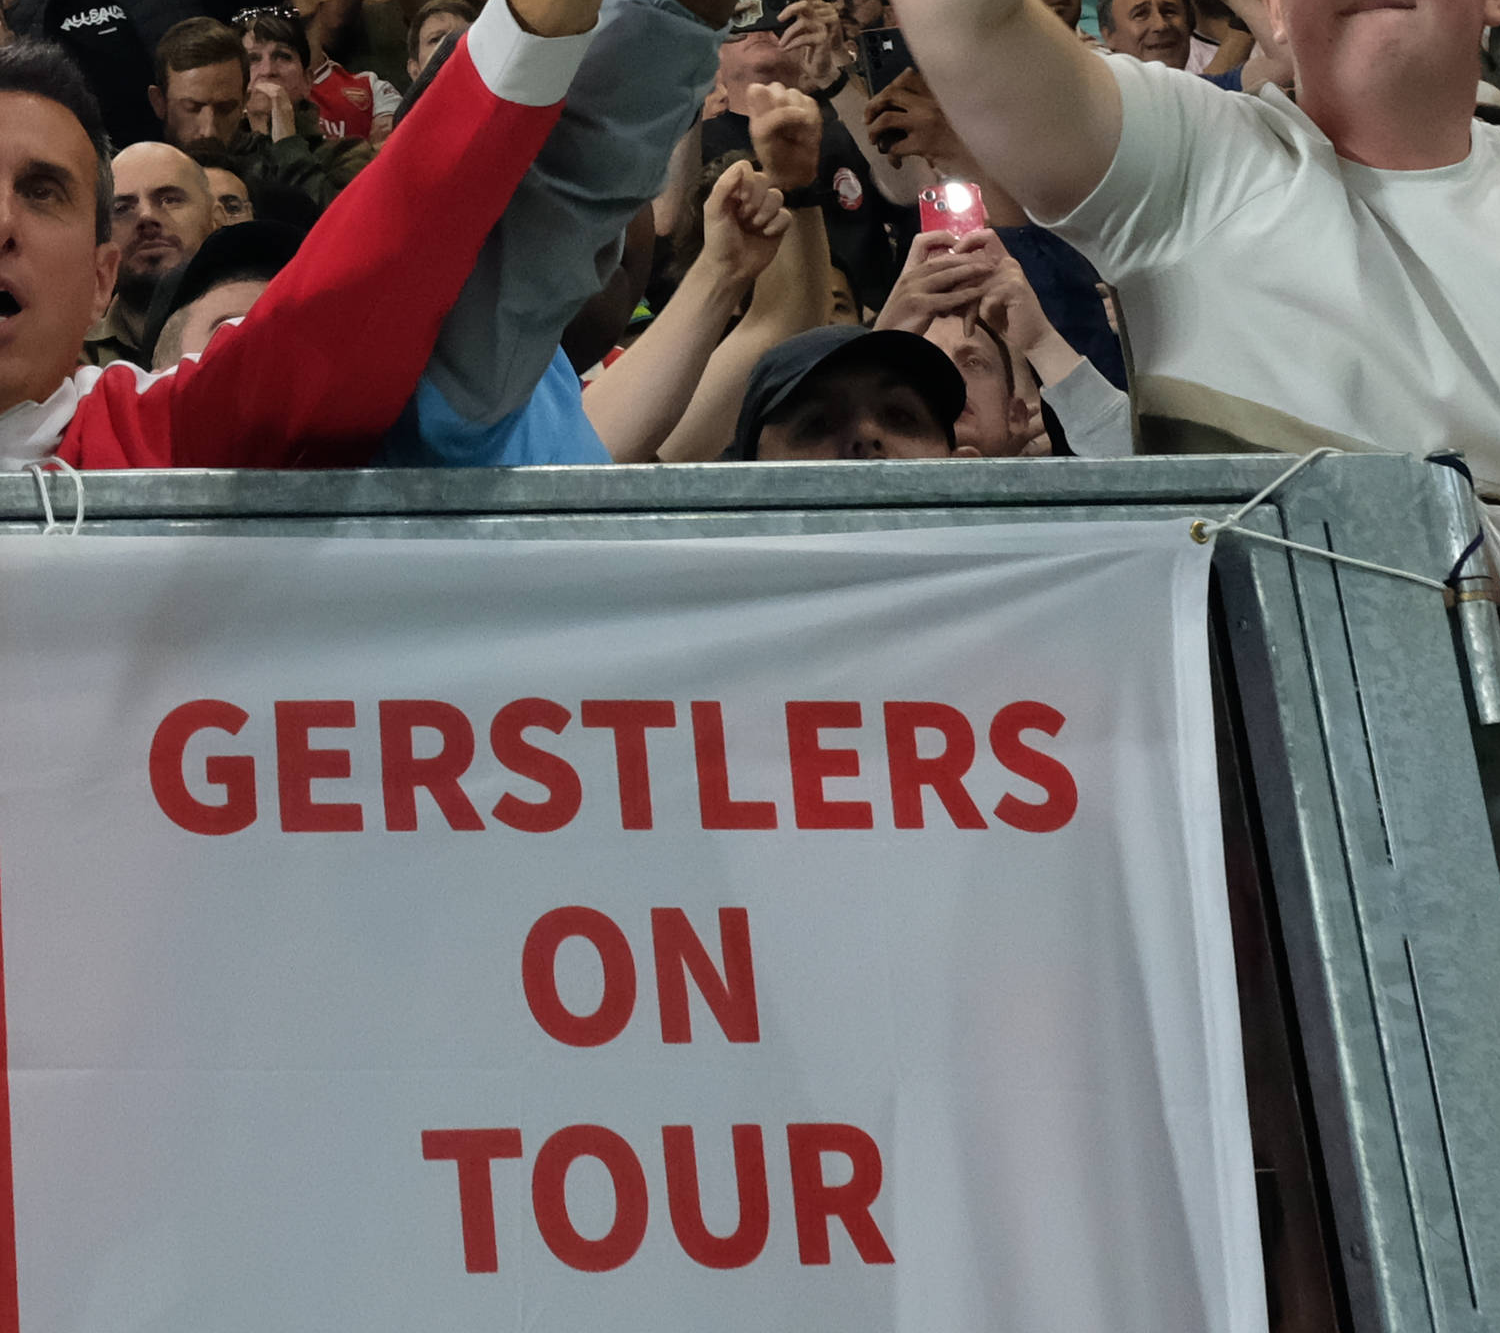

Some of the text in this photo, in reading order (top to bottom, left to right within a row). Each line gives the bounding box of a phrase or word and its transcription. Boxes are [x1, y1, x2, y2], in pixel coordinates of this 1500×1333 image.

[149, 698, 1078, 836] GERSTLERS
[521, 906, 760, 1048] ON
[421, 1122, 896, 1273] TOUR
